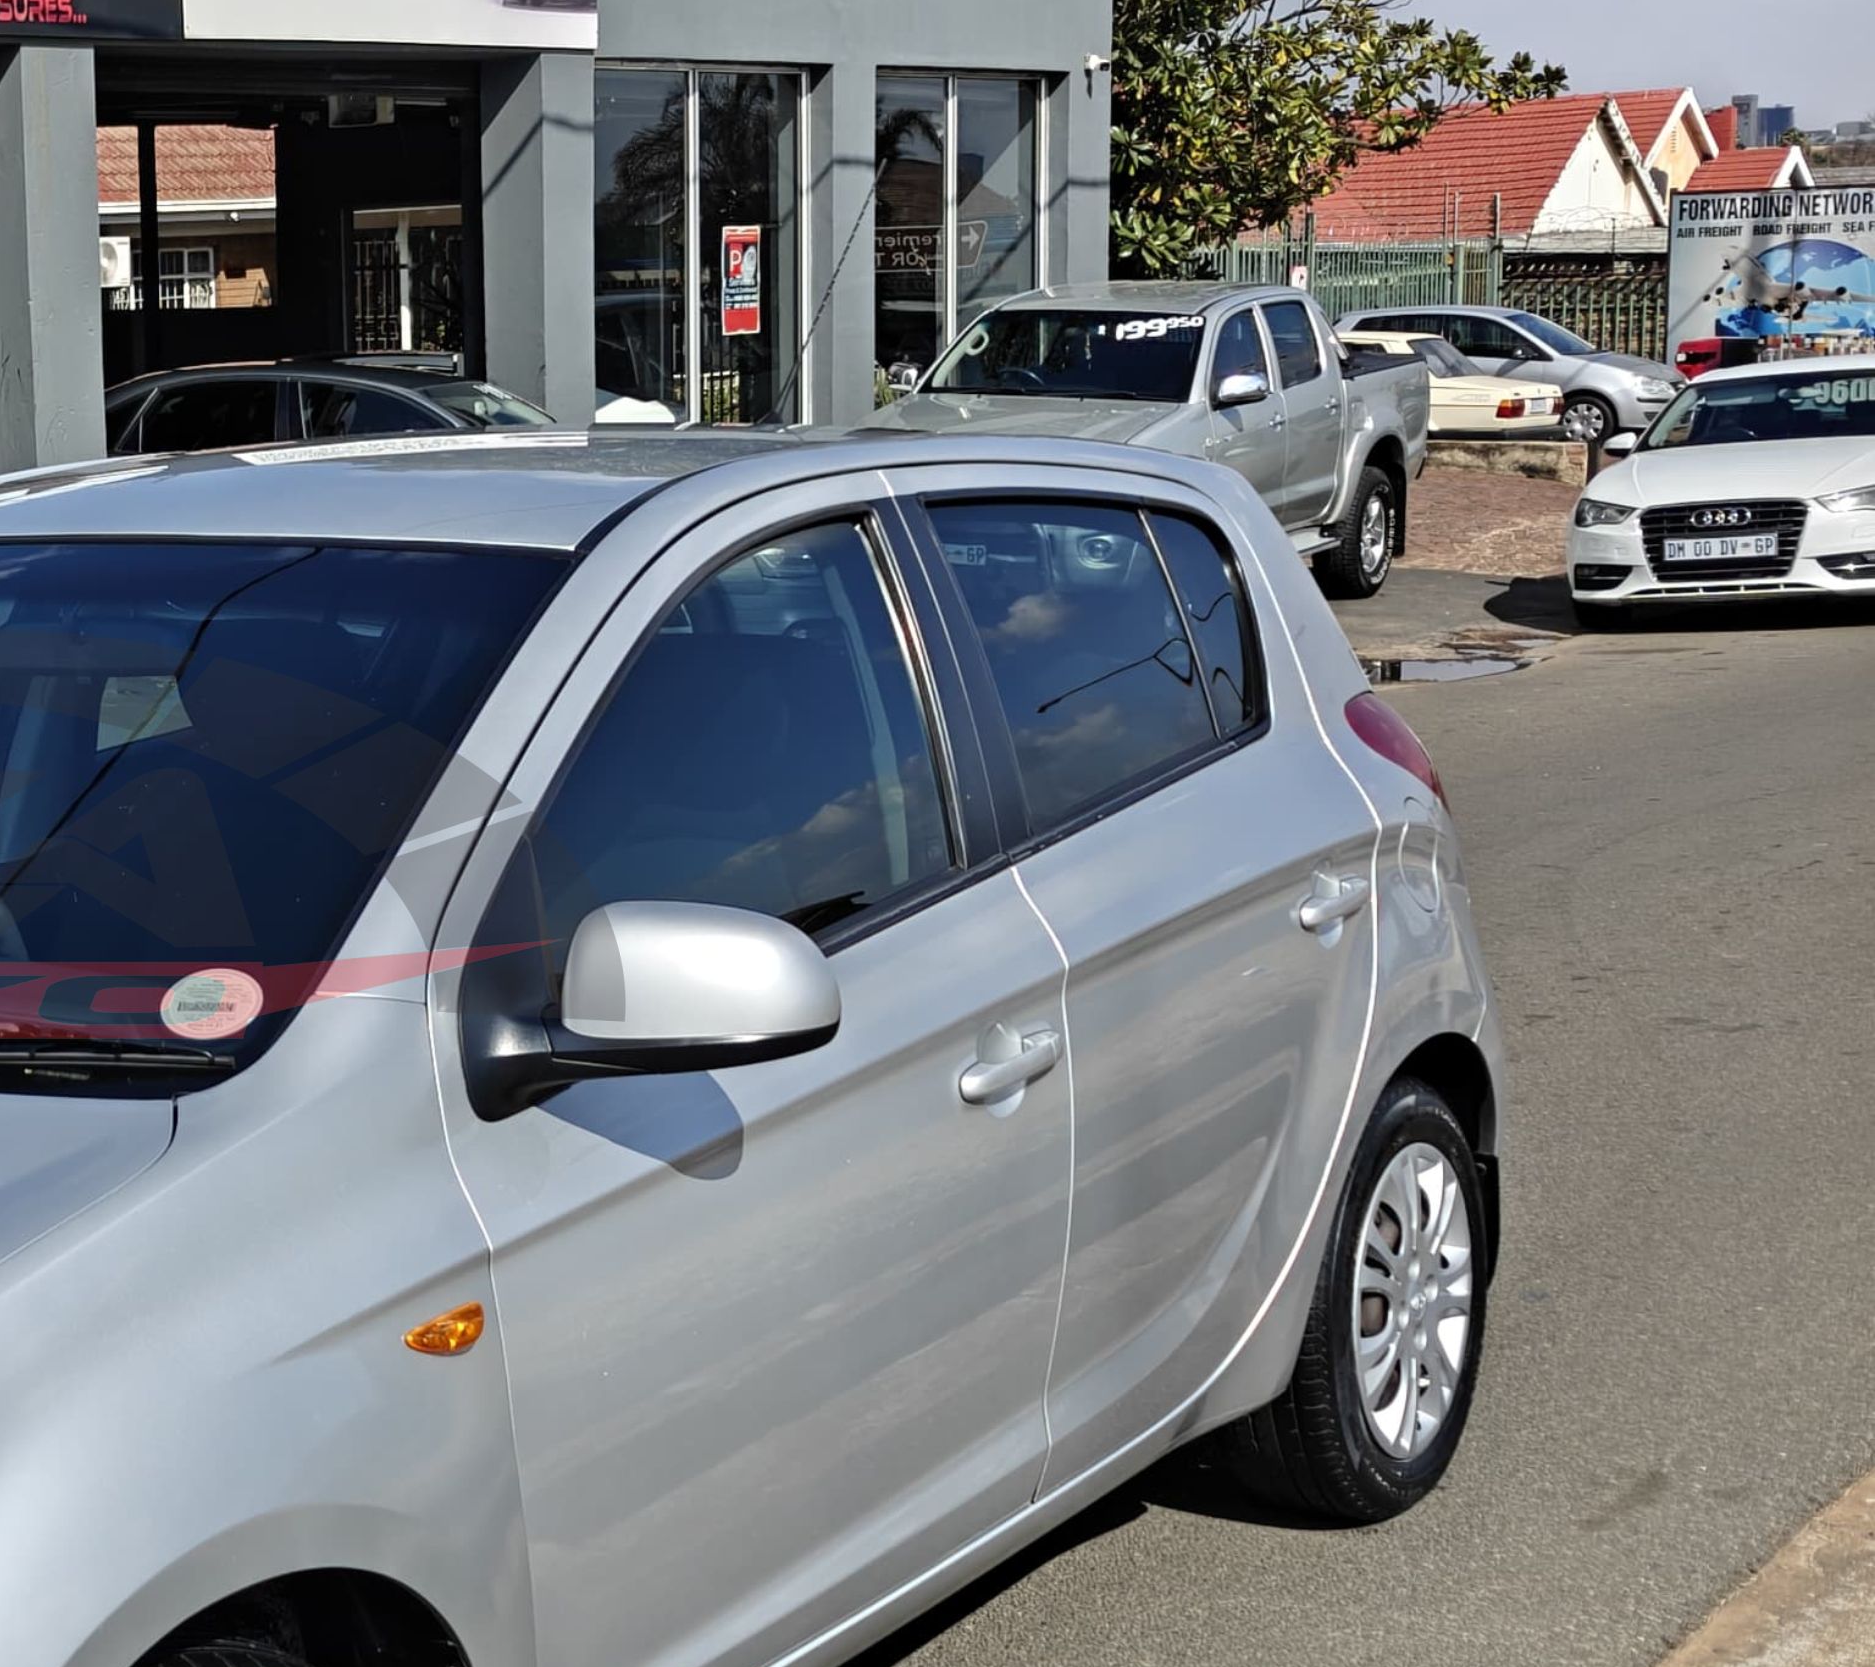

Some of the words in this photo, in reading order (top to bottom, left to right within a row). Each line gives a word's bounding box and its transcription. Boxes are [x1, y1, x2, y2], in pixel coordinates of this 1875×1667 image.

[1679, 194, 1792, 221] FORWARDING
[1676, 227, 1695, 238] AIR
[1699, 225, 1743, 238] FREIGHT
[1753, 223, 1782, 236] ROAD
[1786, 222, 1832, 235] FREIGHT
[1842, 221, 1865, 233] SEA
[967, 547, 984, 563] GP
[1667, 542, 1686, 559] DM
[1720, 539, 1738, 556] DV
[1754, 537, 1774, 553] GP
